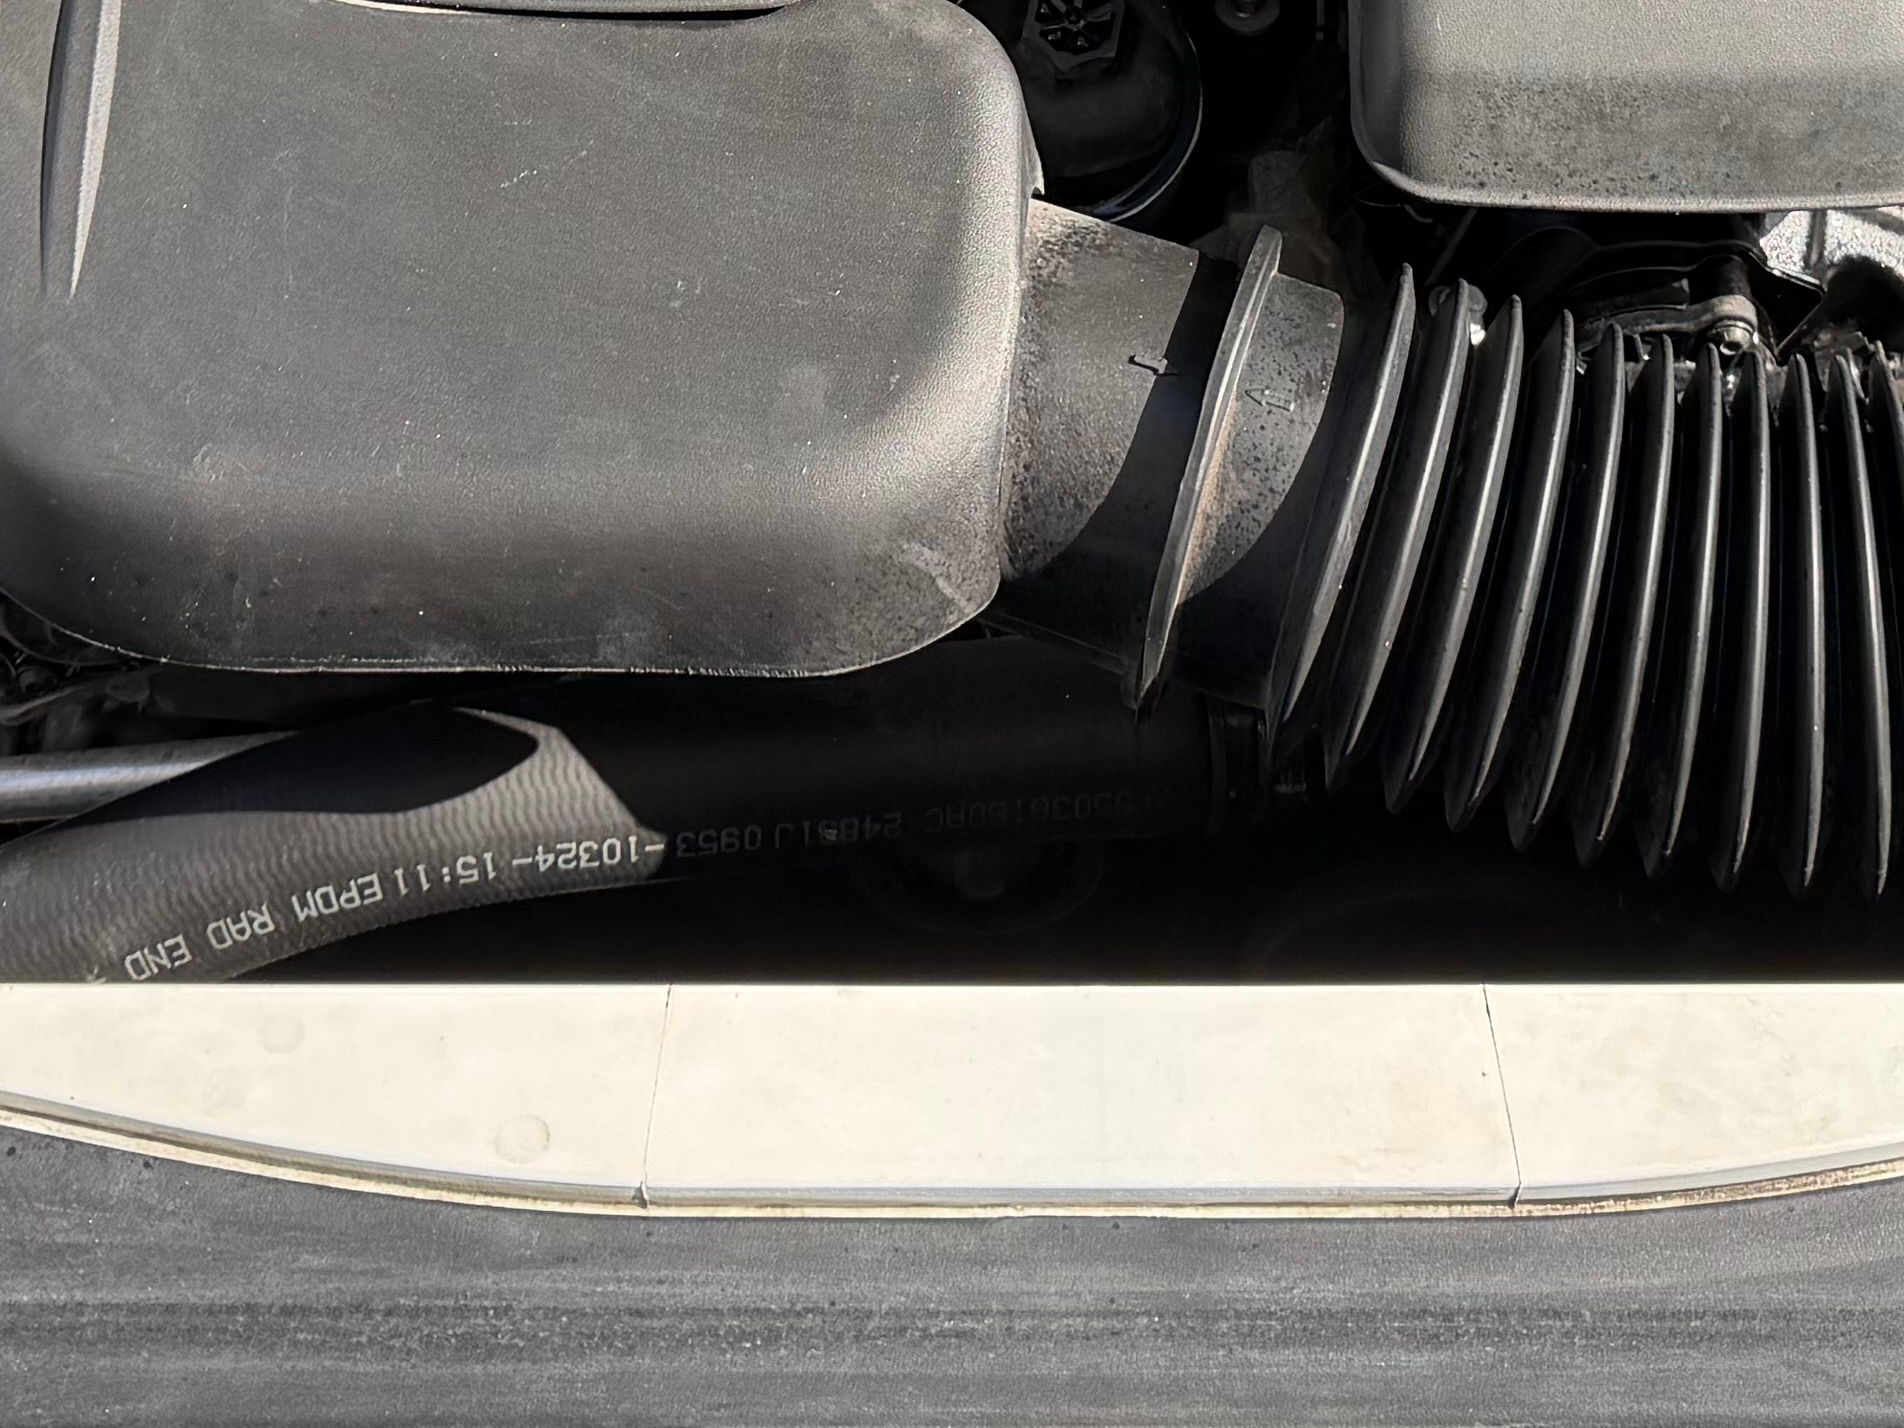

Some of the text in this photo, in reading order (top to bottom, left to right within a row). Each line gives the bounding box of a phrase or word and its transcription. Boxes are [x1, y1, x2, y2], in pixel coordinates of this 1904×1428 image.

[291, 873, 383, 919] EPDM
[391, 851, 496, 895] 15:11
[206, 904, 274, 951] RAD
[123, 932, 192, 981] END
